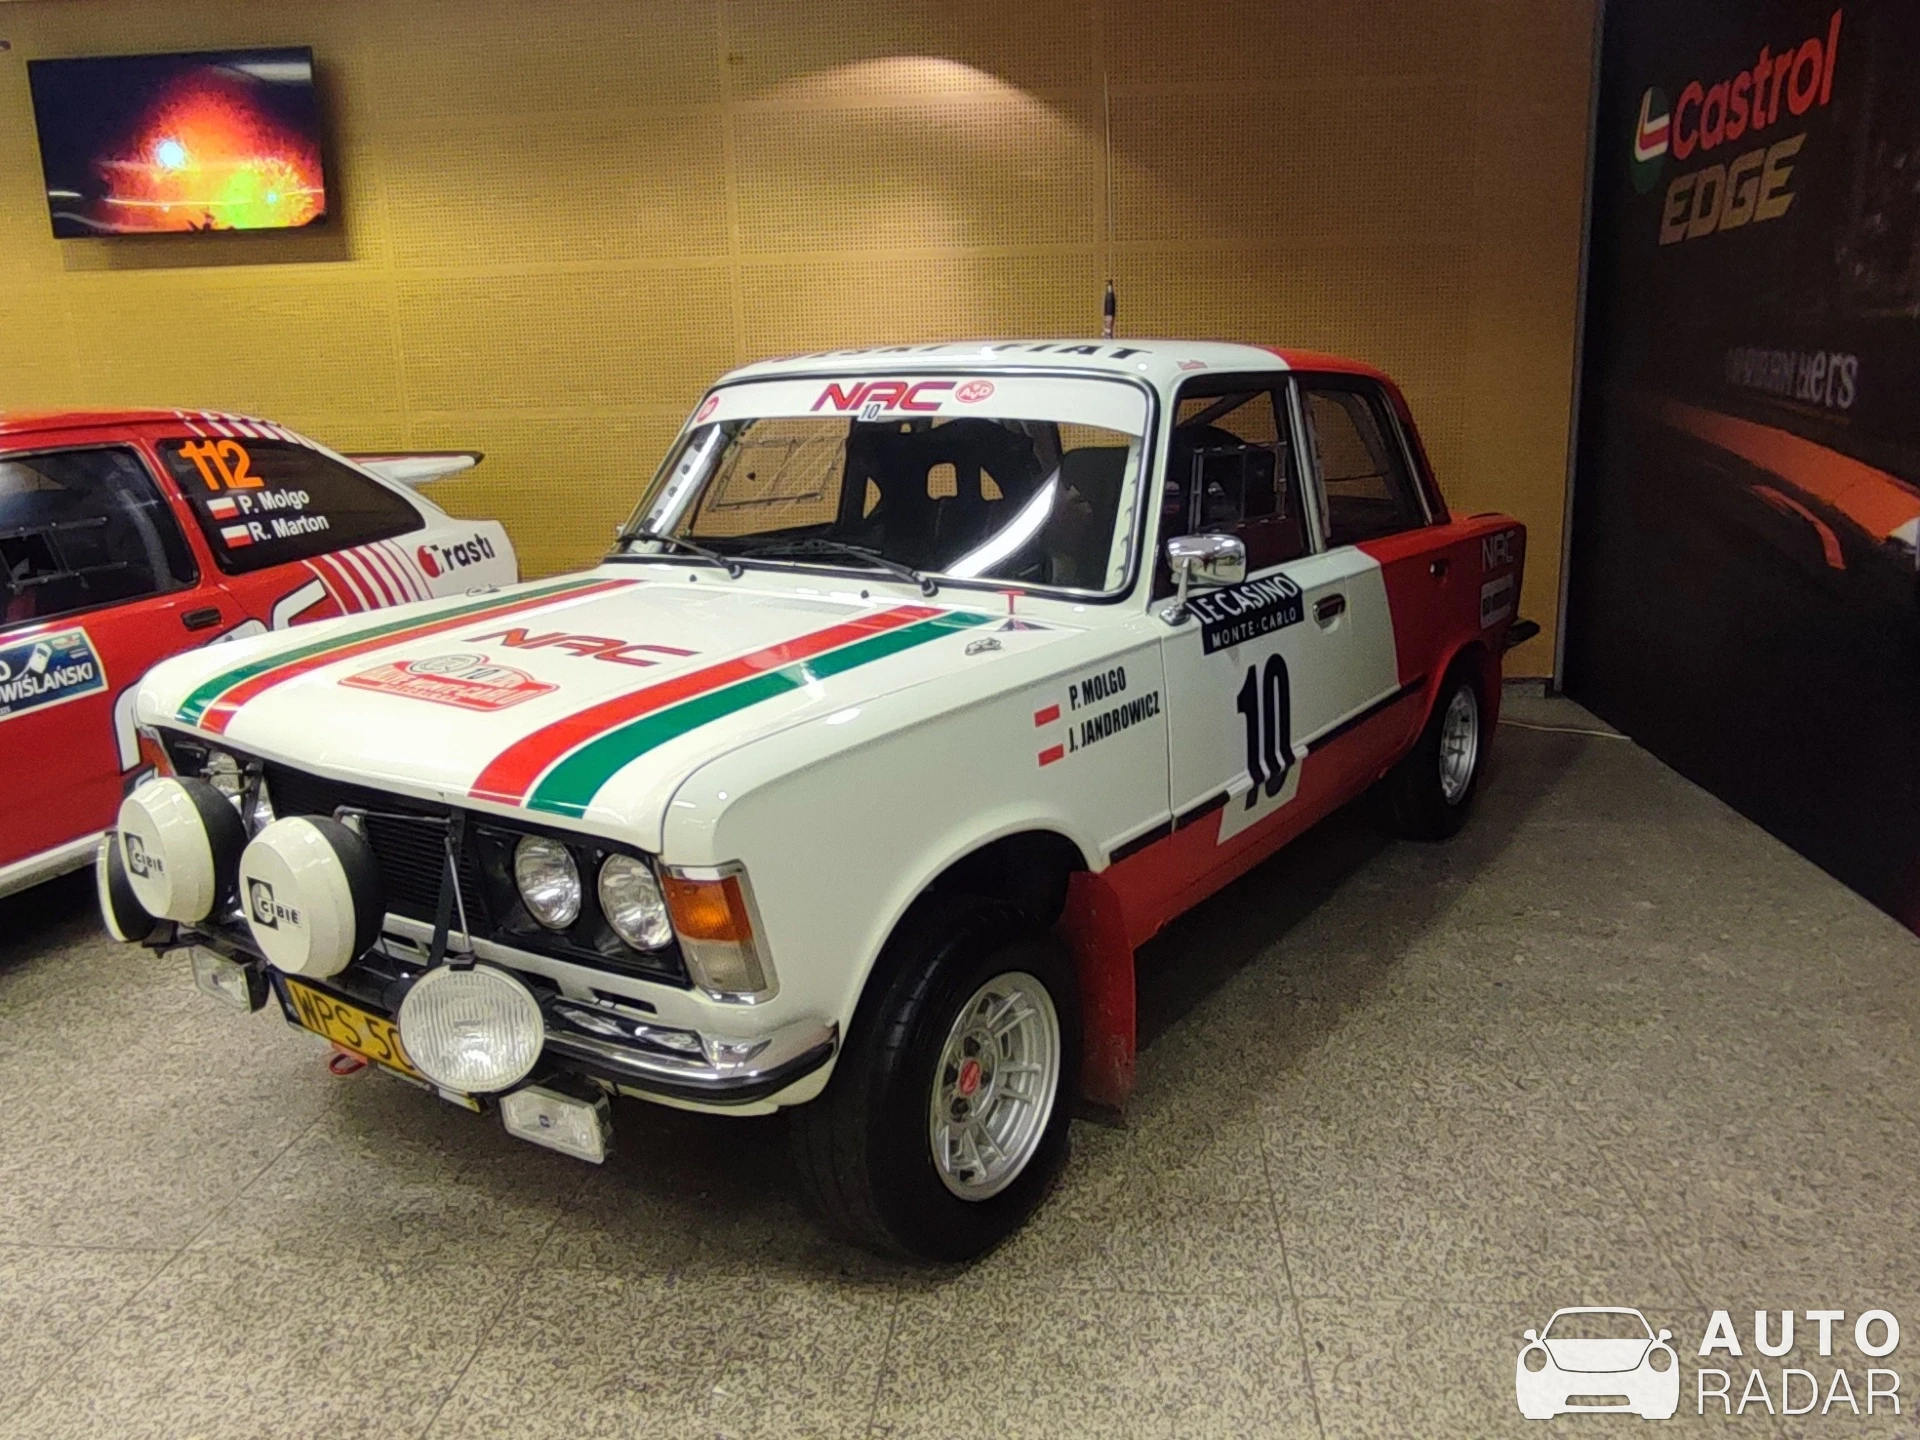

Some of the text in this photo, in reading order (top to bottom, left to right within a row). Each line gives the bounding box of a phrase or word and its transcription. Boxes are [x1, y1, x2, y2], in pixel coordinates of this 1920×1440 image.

[1671, 8, 1842, 160] Castrol
[1659, 132, 1807, 246] EDGE
[991, 342, 1153, 360] FIAT
[860, 404, 880, 420] 10
[179, 440, 265, 491] 112
[237, 488, 310, 515] P. Molgo
[250, 514, 330, 542] R. Marton
[1185, 576, 1299, 625] LE CASINO
[1068, 666, 1127, 711] P. MOLGO
[1068, 690, 1161, 754] J. JANDROWICZ
[1236, 653, 1296, 812] 10
[291, 984, 362, 1048] WPS
